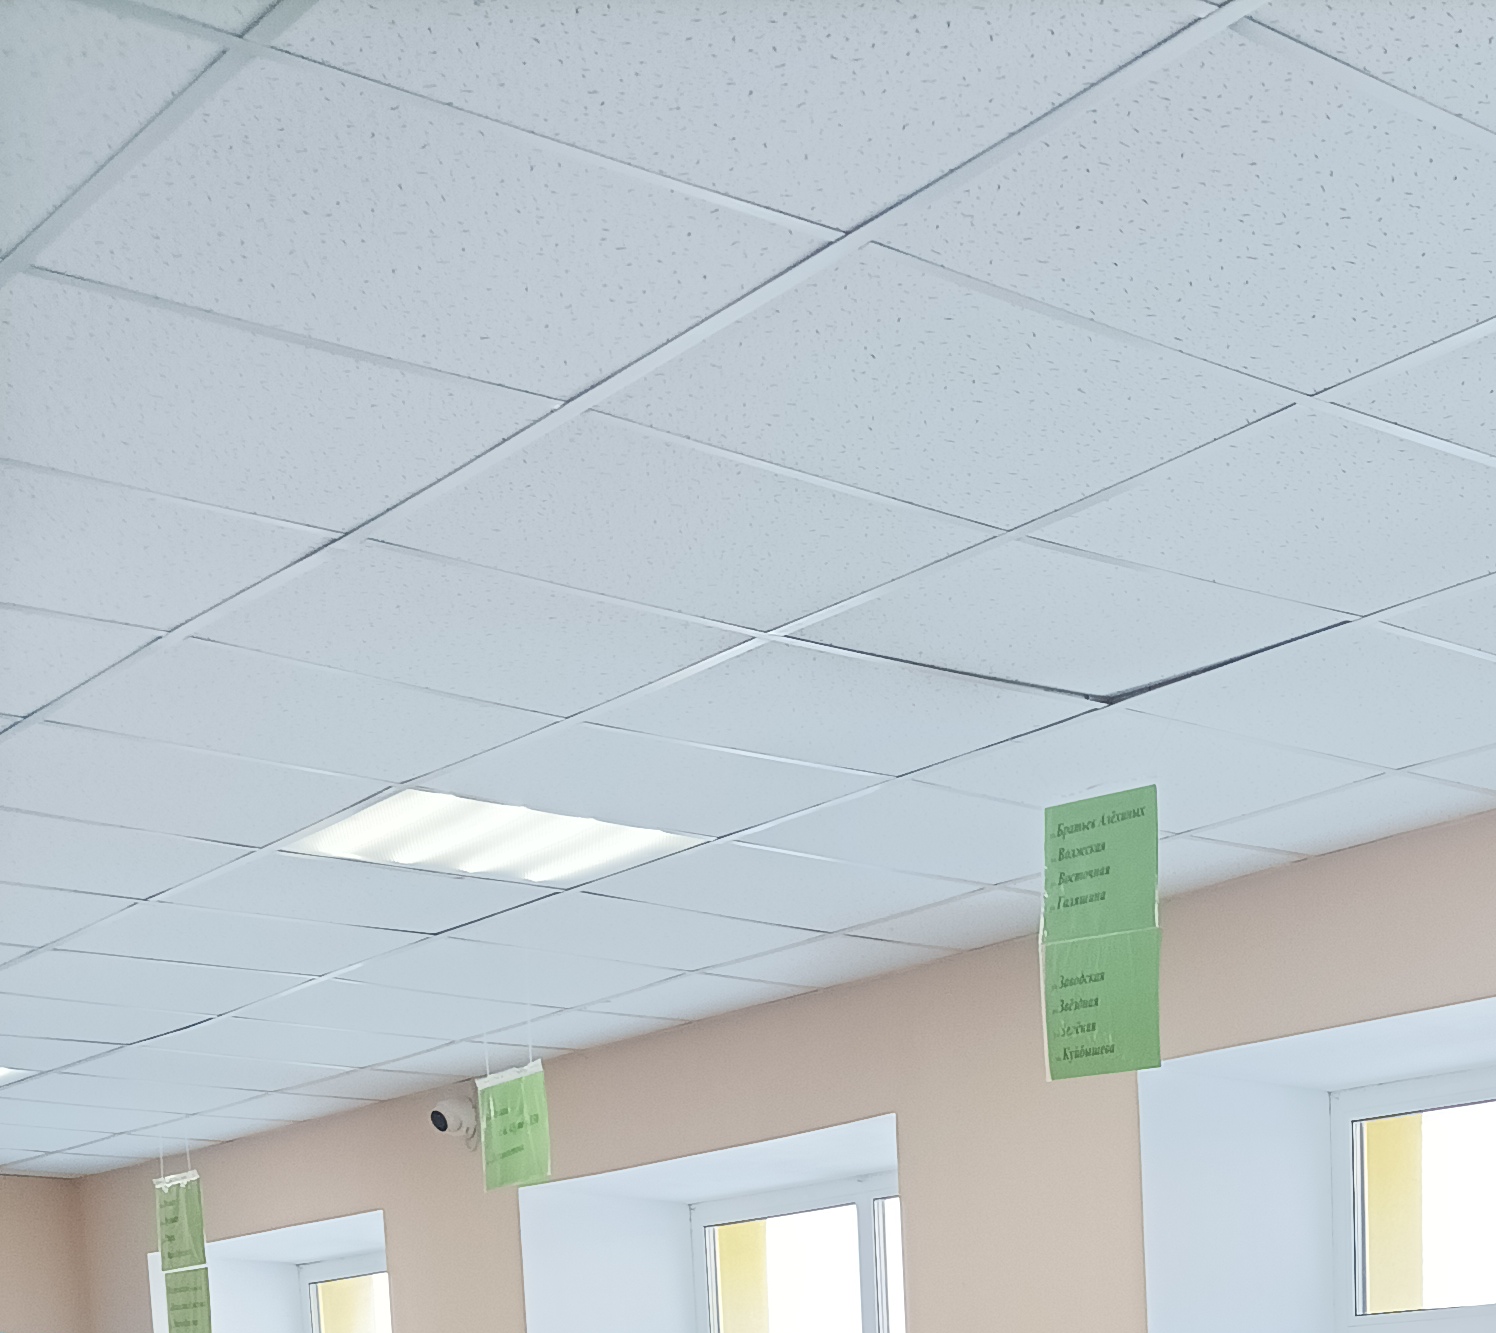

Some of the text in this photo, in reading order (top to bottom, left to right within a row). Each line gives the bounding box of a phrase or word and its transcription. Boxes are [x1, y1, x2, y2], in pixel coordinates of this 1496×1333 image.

[1058, 842, 1106, 861] Волжская
[1058, 866, 1110, 886] Восточная
[1063, 1044, 1115, 1063] Куйбышева
